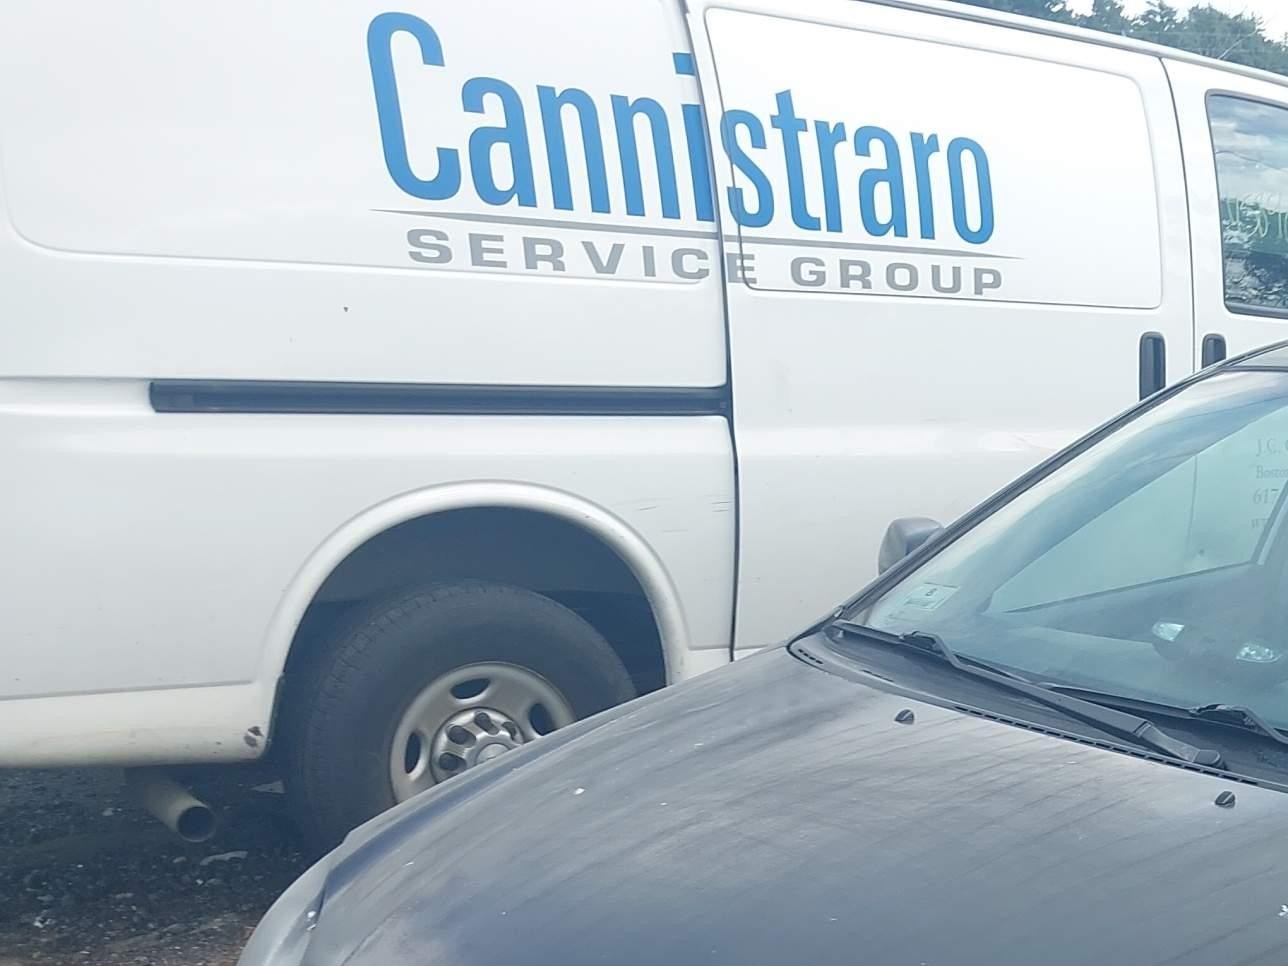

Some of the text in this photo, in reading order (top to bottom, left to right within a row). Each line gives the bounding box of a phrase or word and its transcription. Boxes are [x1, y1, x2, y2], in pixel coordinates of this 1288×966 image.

[366, 12, 995, 245] Cannistraro
[407, 228, 1002, 295] SERVICE GROUP
